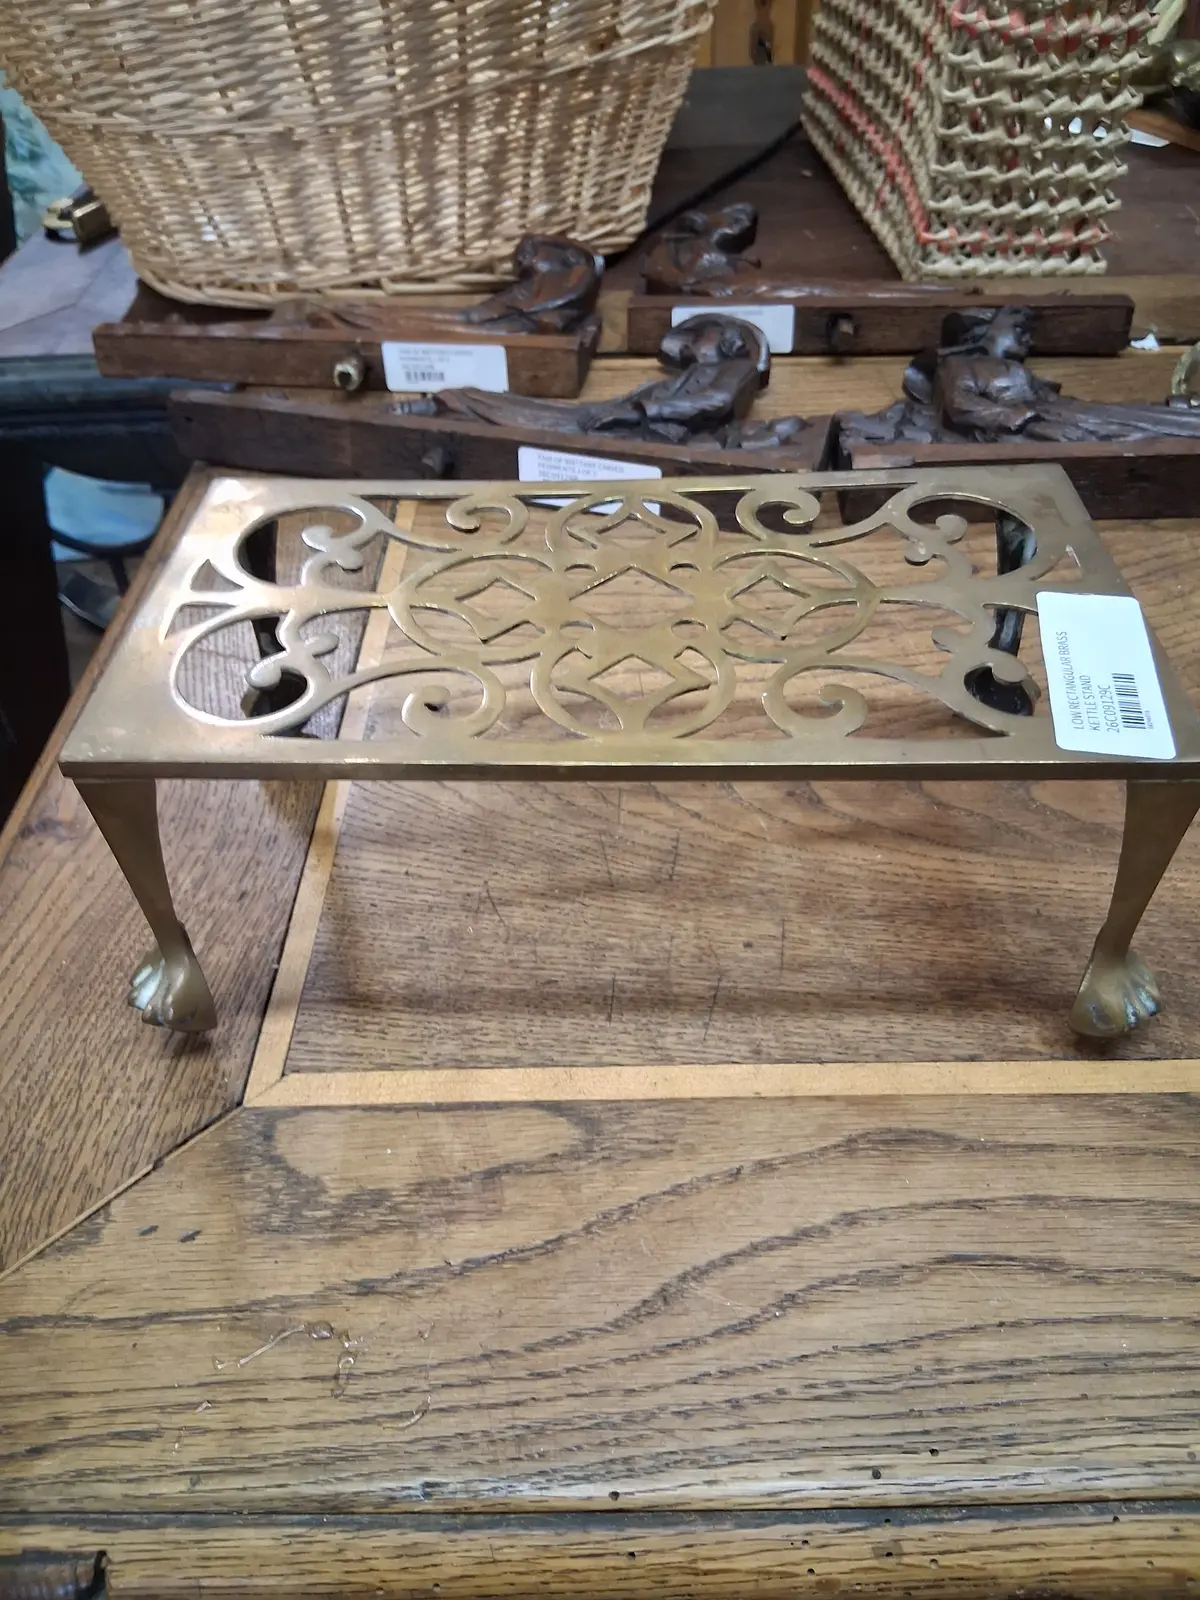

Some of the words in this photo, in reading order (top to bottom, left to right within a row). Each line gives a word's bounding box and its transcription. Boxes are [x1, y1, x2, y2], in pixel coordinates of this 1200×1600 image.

[1056, 631, 1070, 655] BRASS
[1060, 656, 1080, 709] RECTANGULAR
[1079, 675, 1095, 700] STAND
[1069, 711, 1085, 730] LOW
[1085, 701, 1101, 731] KETTLE
[1097, 684, 1120, 733] 26C09129C
